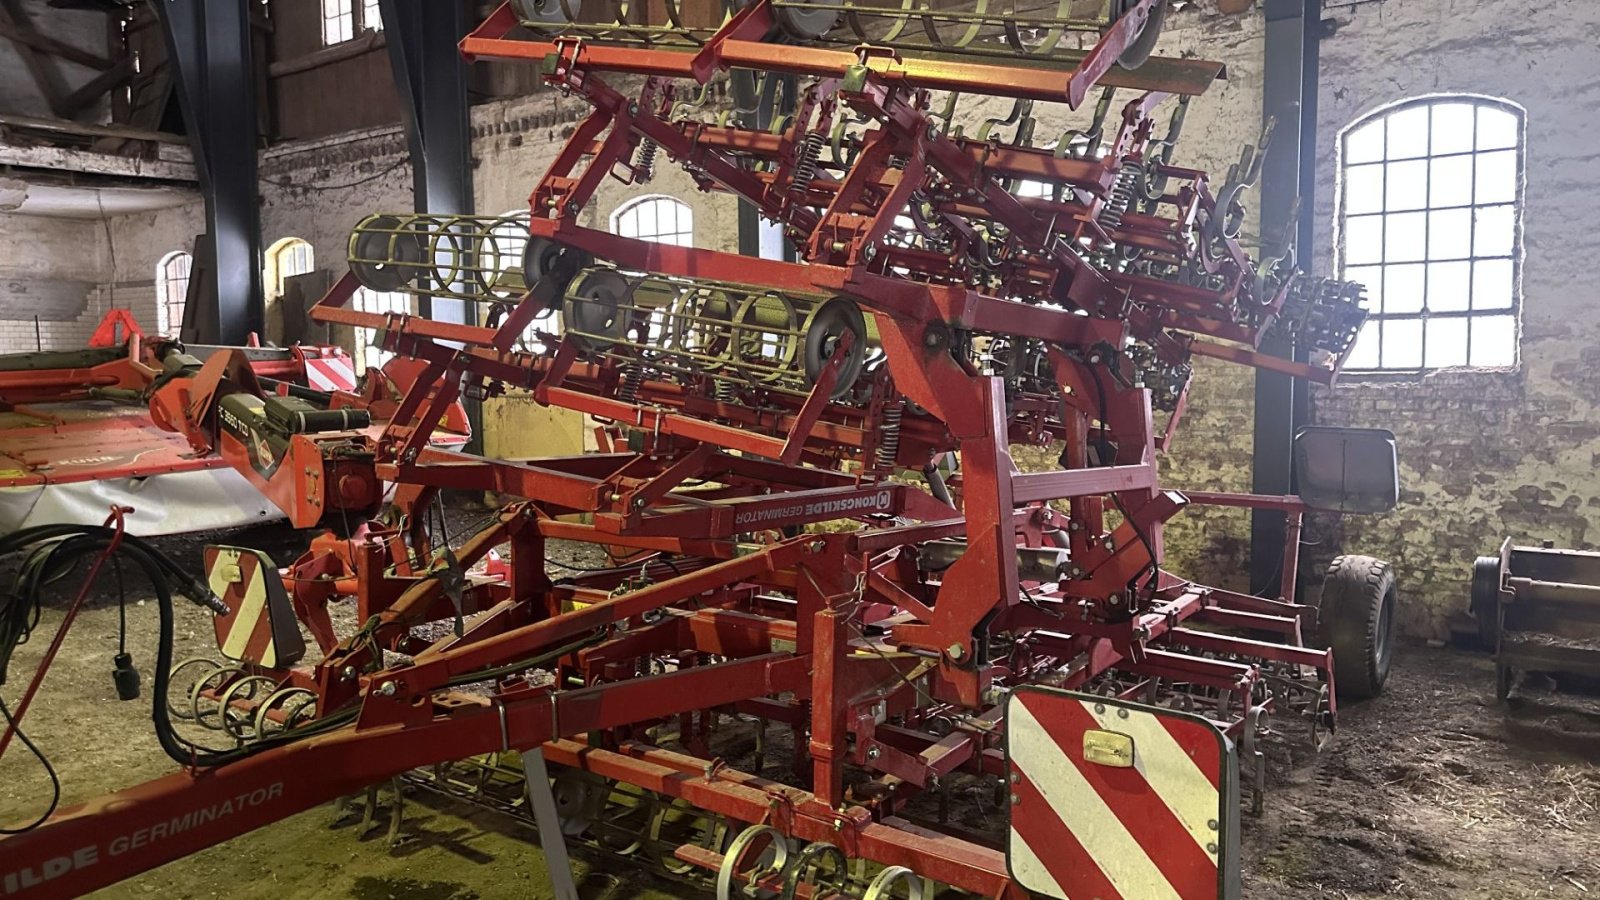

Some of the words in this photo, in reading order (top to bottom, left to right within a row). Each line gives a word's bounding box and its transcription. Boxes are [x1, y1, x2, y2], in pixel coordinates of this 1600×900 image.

[735, 505, 803, 524] GERMINATOR
[805, 495, 877, 515] KONGSKILDE
[0, 844, 99, 897] ILDE
[108, 781, 284, 857] GERMINATOR
